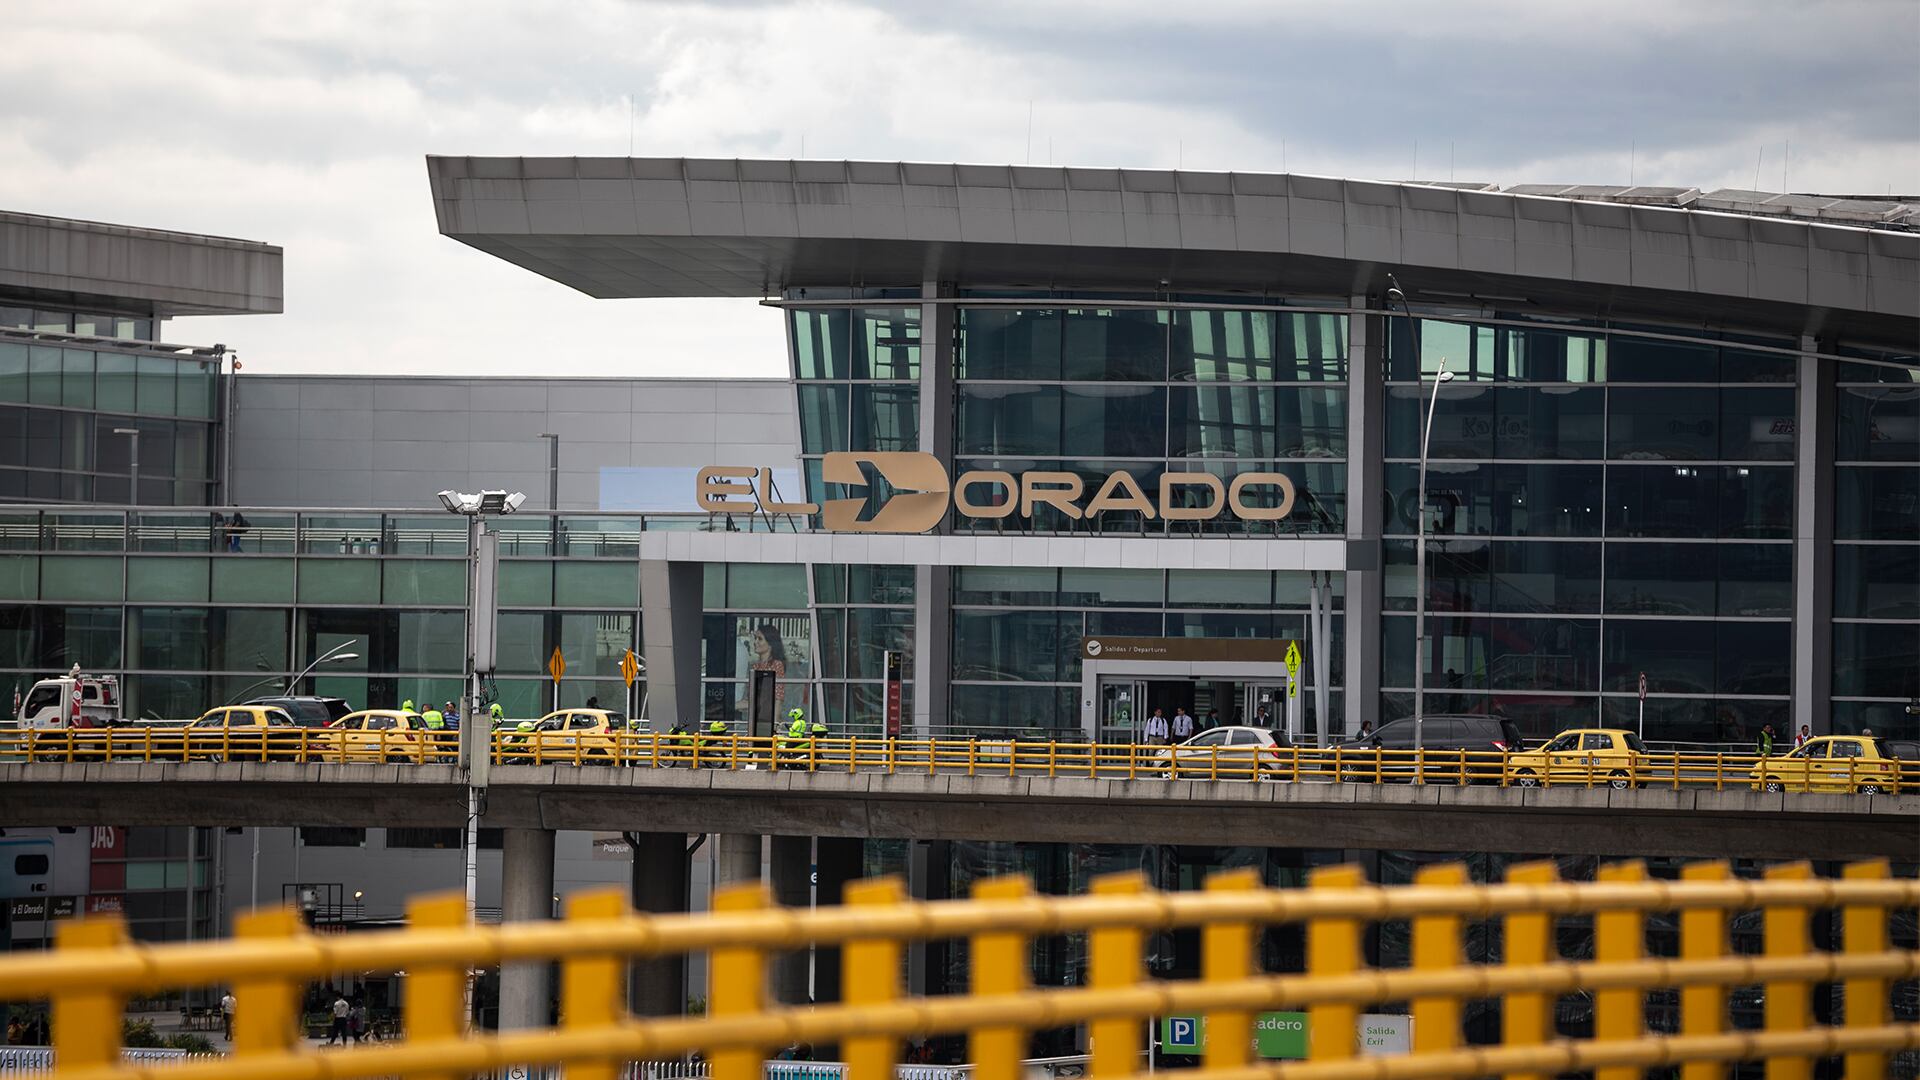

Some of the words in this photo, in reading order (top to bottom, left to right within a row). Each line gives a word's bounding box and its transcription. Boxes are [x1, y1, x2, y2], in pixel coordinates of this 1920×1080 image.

[696, 466, 819, 516] EL
[822, 451, 1295, 532] DORADO
[1105, 645, 1127, 653] Salidas
[1133, 646, 1167, 654] Departures
[17, 904, 23, 914] El
[24, 904, 44, 914] Dorado
[1174, 1020, 1190, 1042] P
[1366, 1026, 1396, 1036] Salida
[1366, 1037, 1385, 1047] Exit
